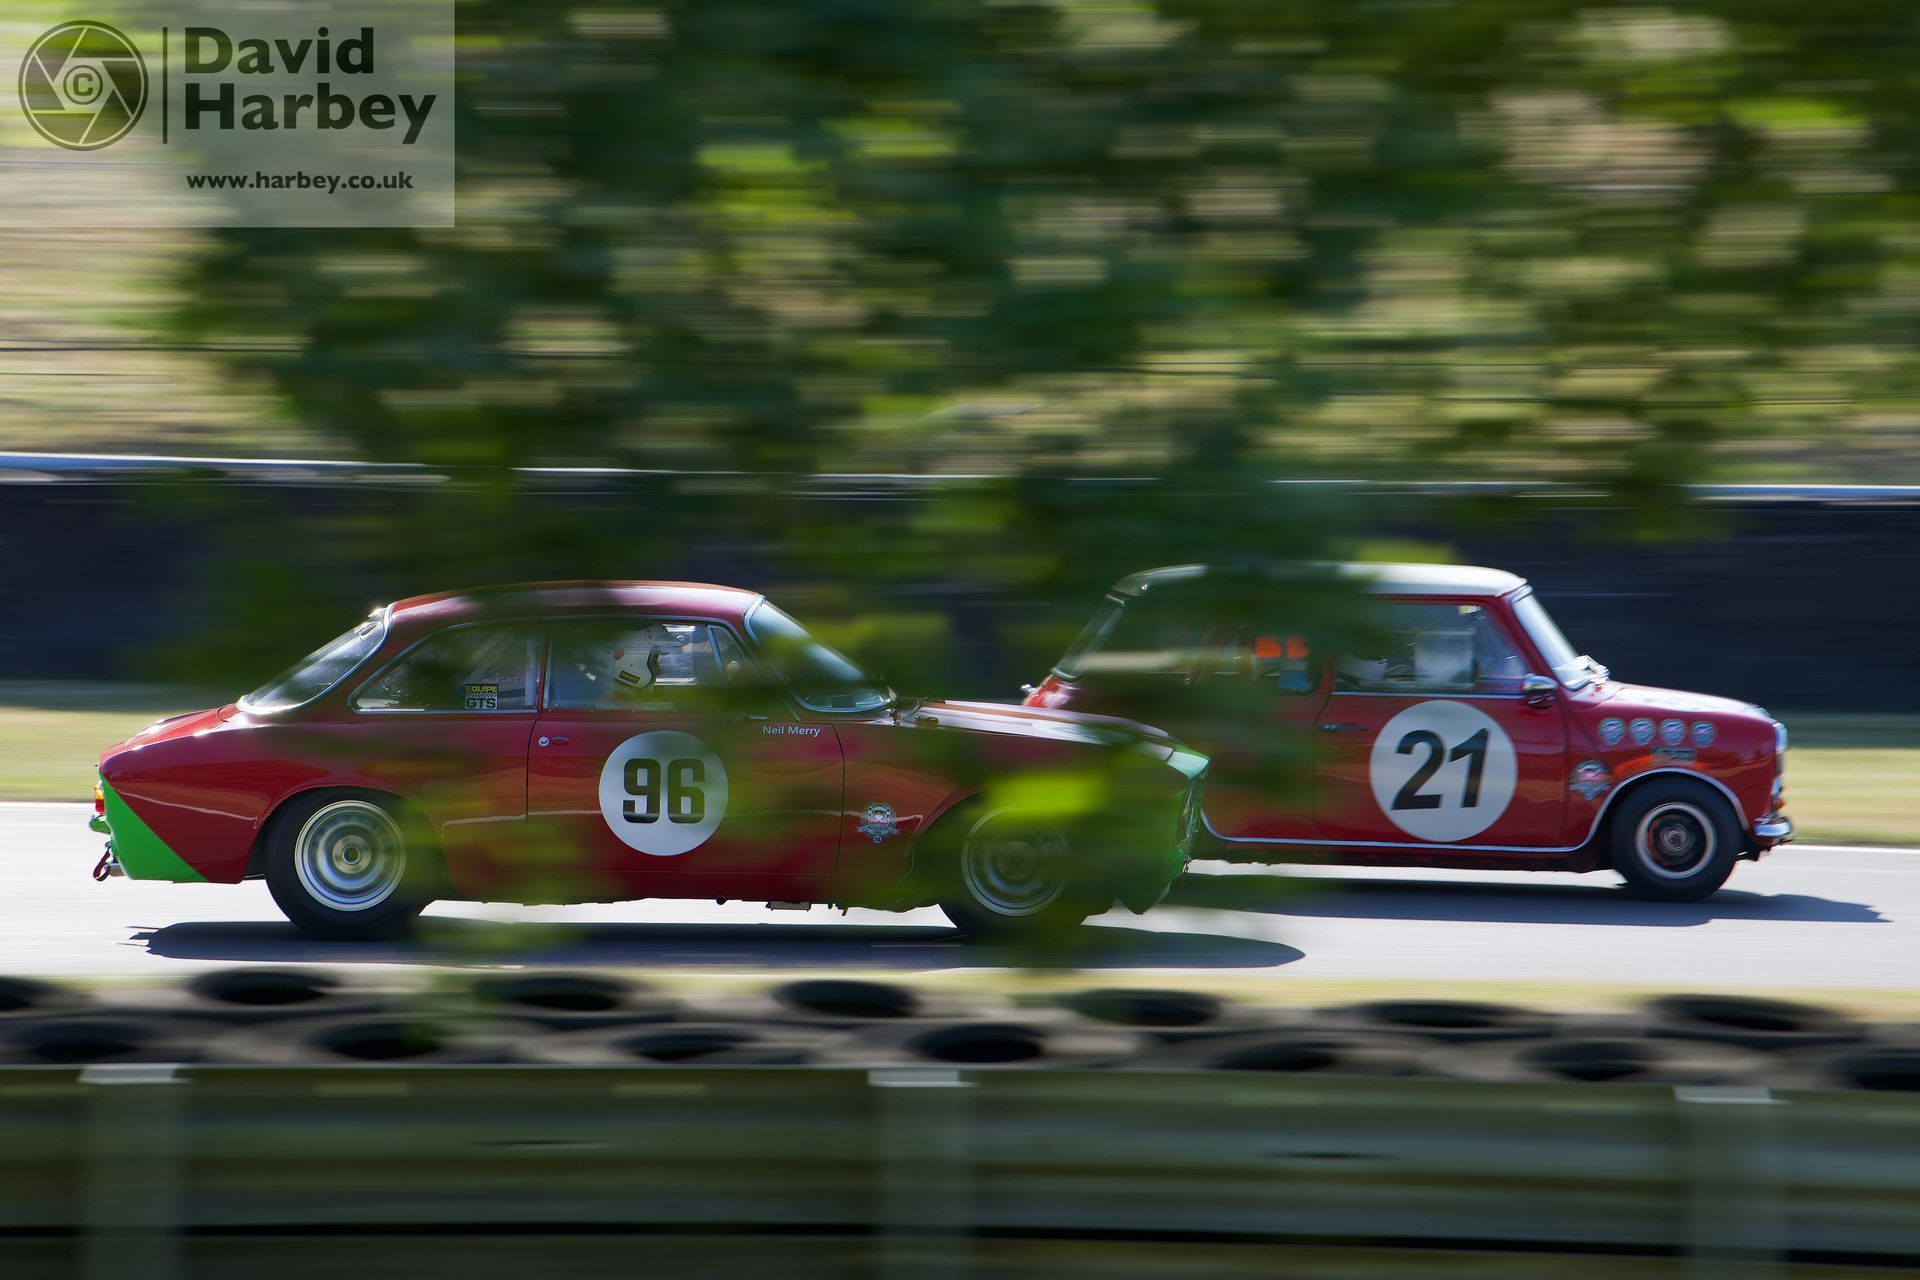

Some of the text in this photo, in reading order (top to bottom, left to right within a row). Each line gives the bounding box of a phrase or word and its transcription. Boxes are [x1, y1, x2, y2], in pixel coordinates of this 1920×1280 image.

[466, 685, 498, 693] EQUIPE
[466, 697, 496, 708] GTS
[763, 726, 821, 738] Neil Merry
[1391, 727, 1489, 810] 21
[623, 758, 705, 824] 96
